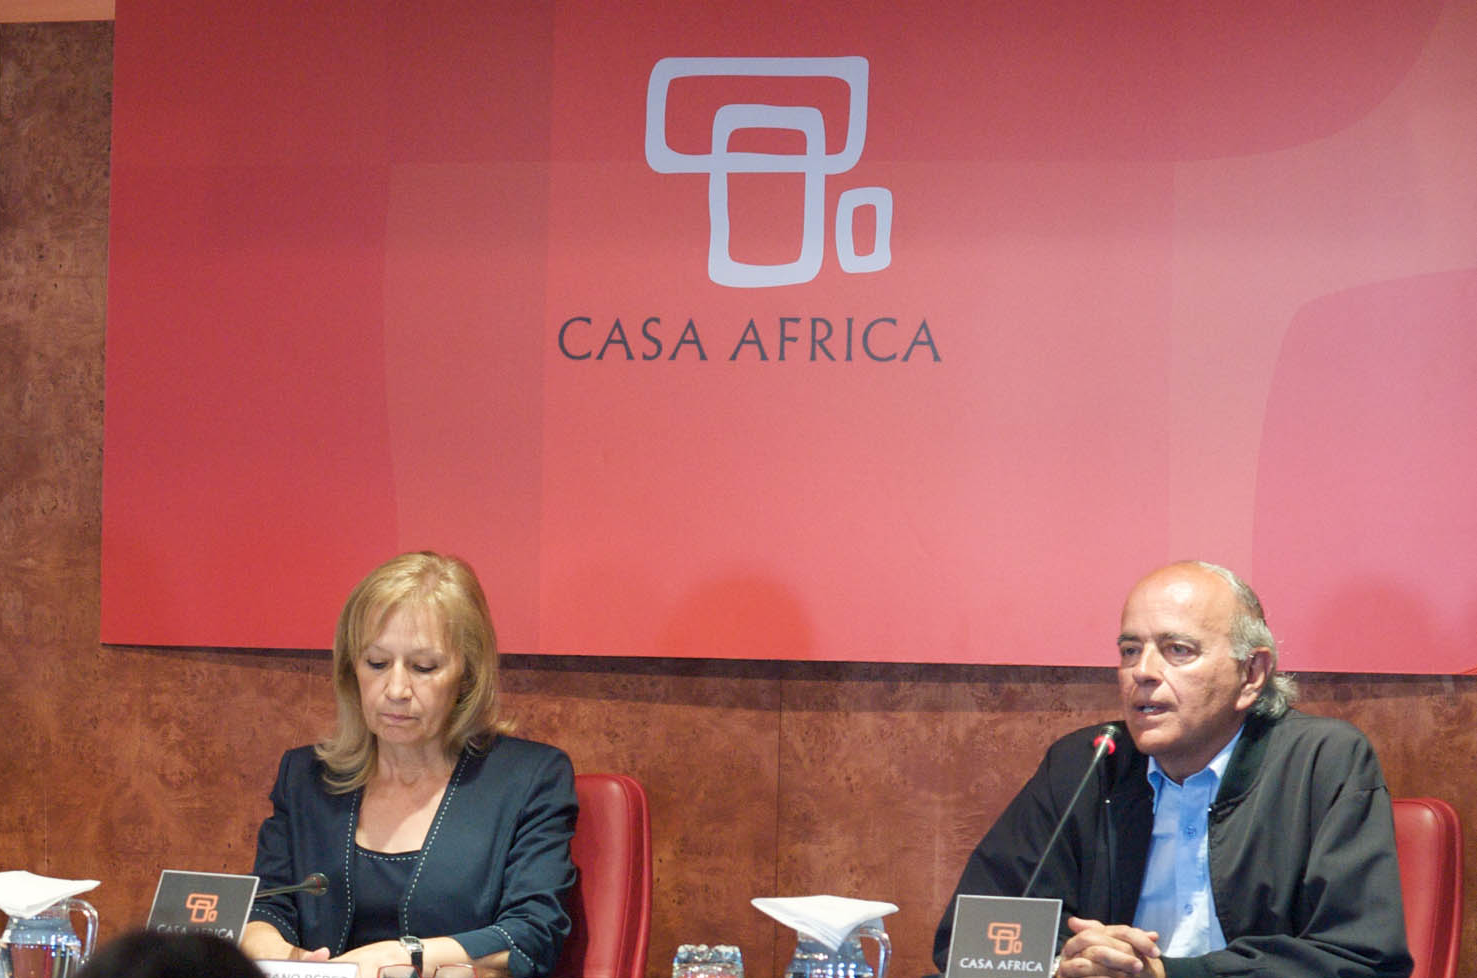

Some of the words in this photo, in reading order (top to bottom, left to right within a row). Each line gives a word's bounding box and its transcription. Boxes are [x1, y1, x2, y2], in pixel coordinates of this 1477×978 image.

[558, 316, 708, 361] CASA
[729, 317, 942, 362] AFRICA
[959, 957, 994, 970] CASA
[996, 960, 1044, 973] AFRICA
